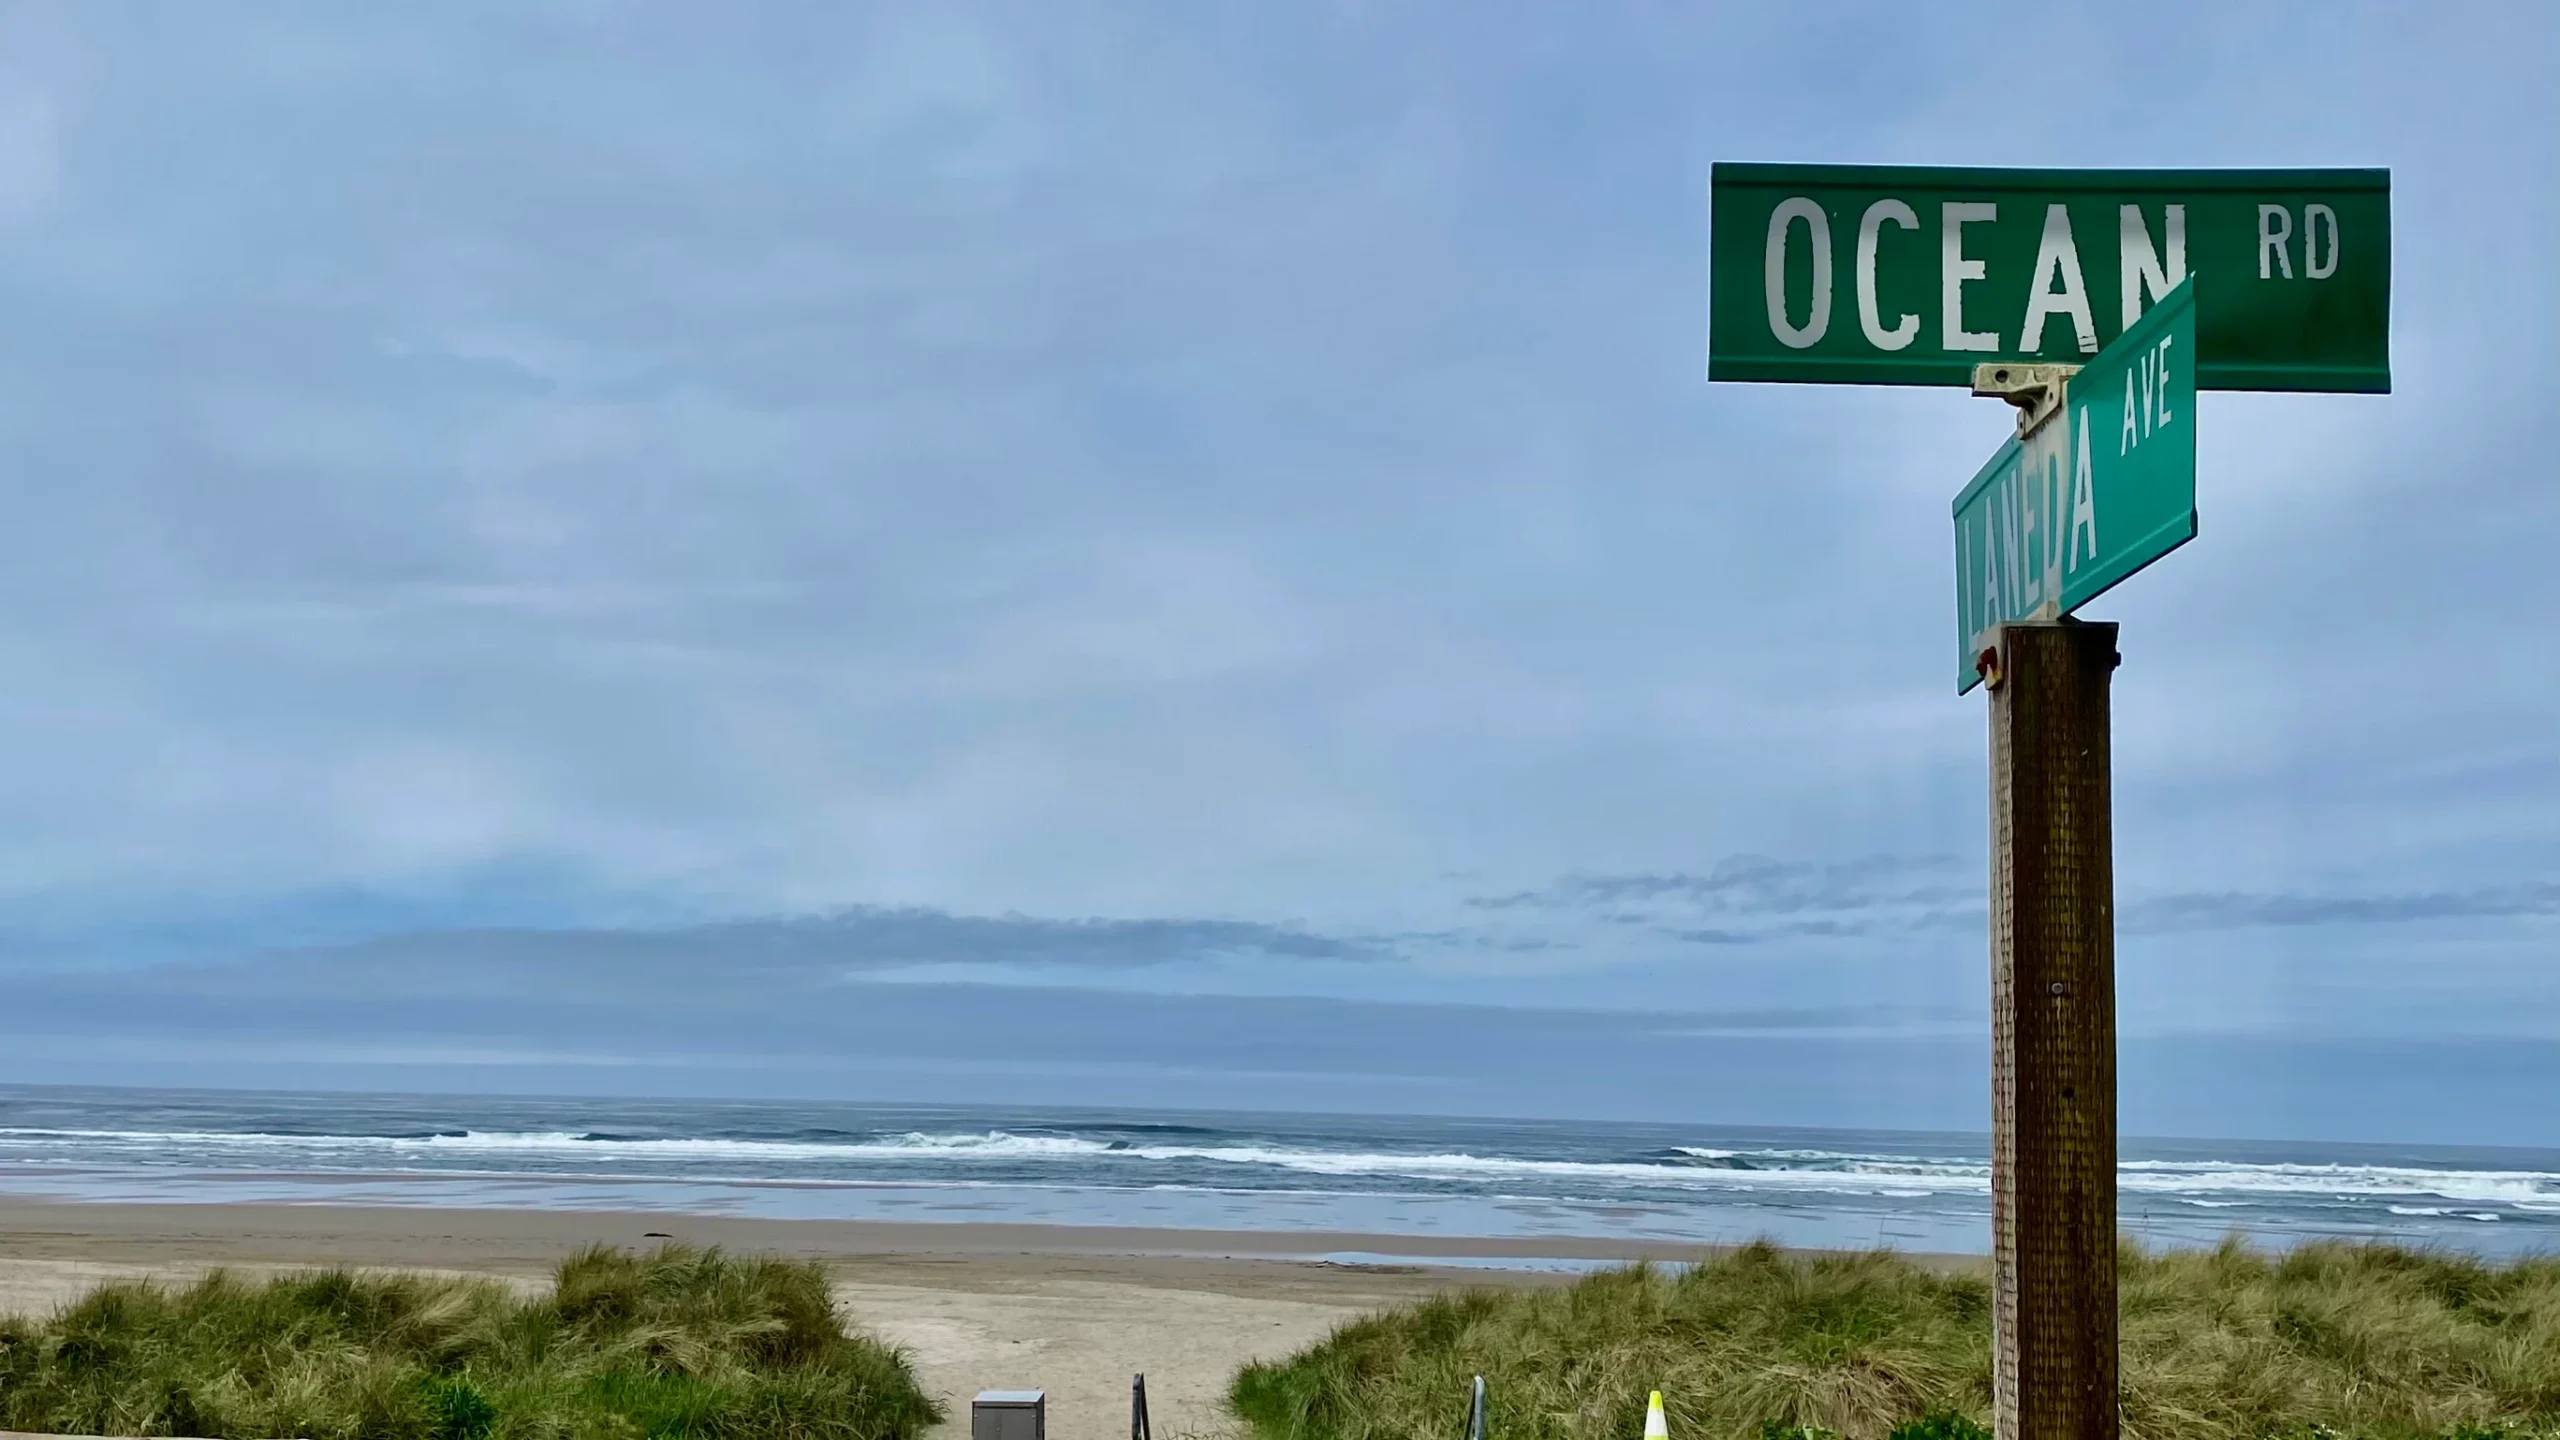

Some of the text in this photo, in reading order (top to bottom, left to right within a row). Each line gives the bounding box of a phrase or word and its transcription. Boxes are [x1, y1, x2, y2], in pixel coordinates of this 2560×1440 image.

[1764, 196, 2340, 353] OCEAN RD
[1964, 333, 2173, 655] LANEDA AVE
